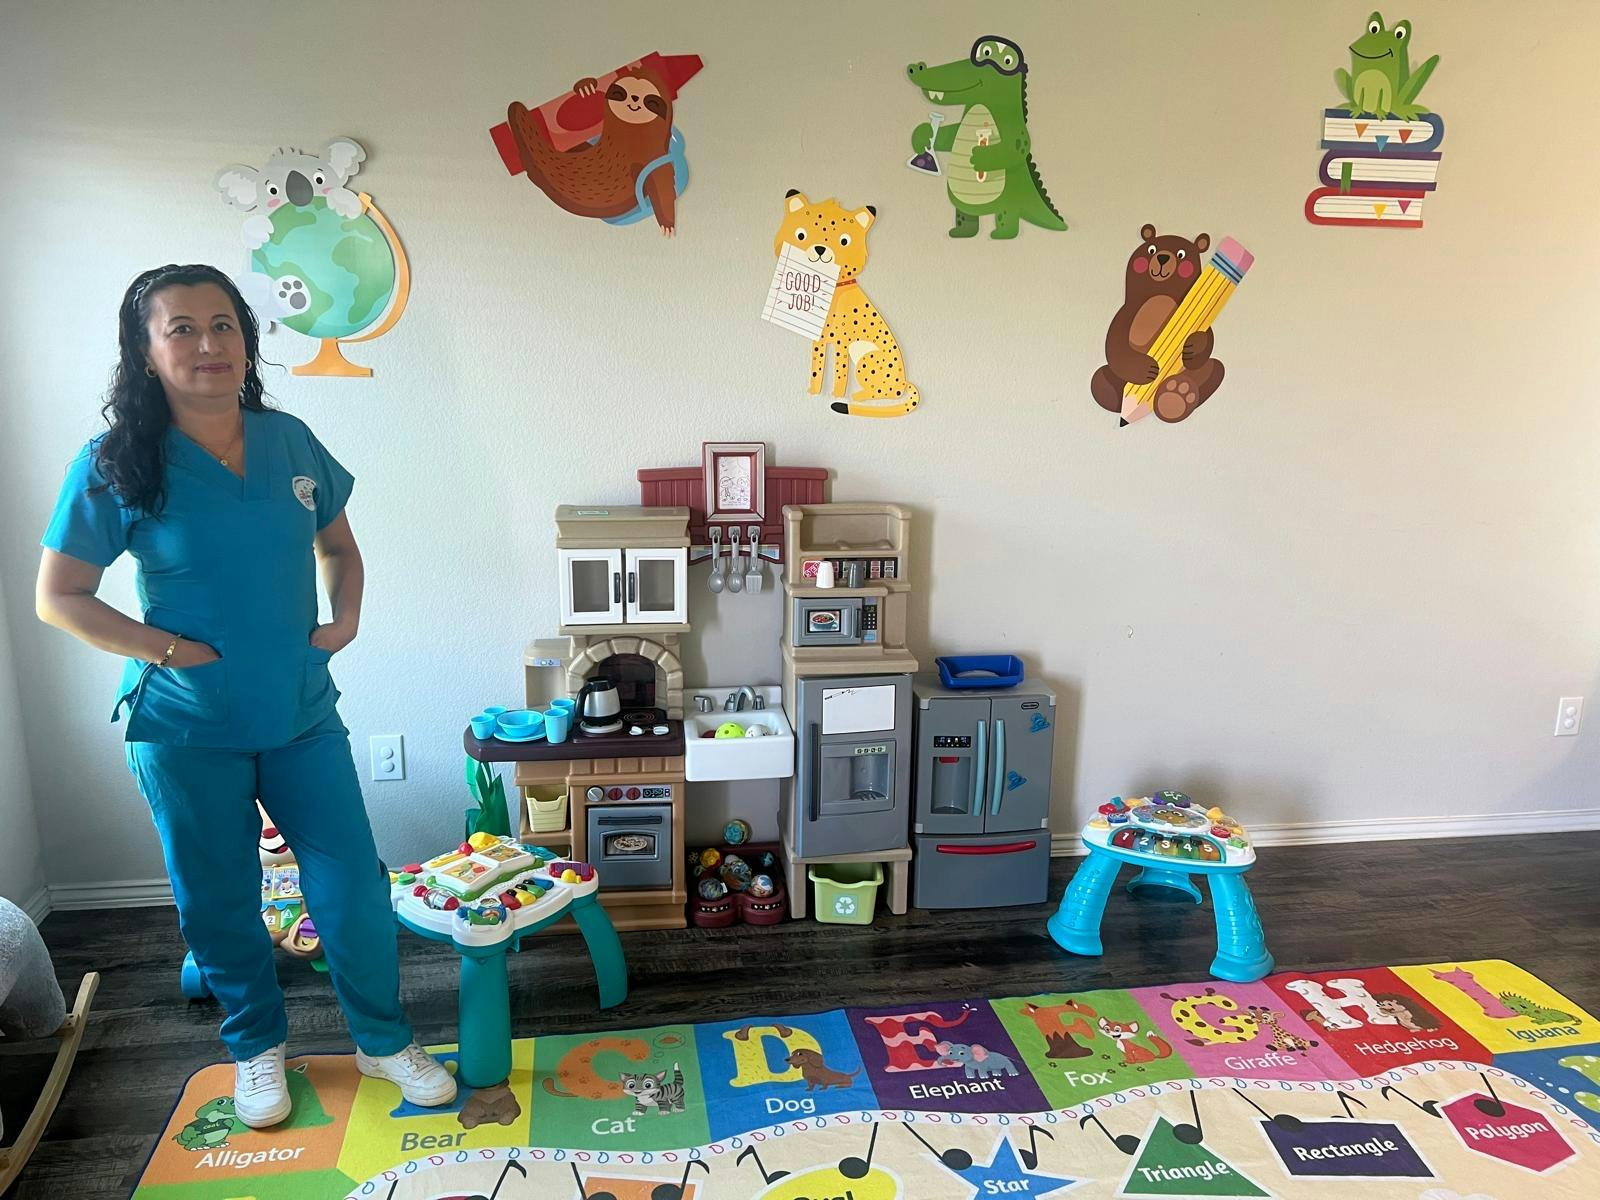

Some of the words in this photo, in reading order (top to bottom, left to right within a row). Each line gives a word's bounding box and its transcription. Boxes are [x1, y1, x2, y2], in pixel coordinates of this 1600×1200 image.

[785, 271, 821, 293] GOOD
[788, 293, 815, 312] JOB!
[1122, 832, 1130, 841] 1
[1139, 837, 1149, 846] 2
[1161, 840, 1171, 849] 3
[1183, 843, 1193, 852] 4
[1203, 844, 1213, 853] 5
[1506, 1025, 1581, 1043] Iguana
[1354, 1036, 1459, 1056] Hedgehog
[1224, 1052, 1298, 1071] Giraffe
[1063, 1070, 1113, 1087] Fox
[908, 1078, 1005, 1100] Elephant
[765, 1097, 816, 1114] Dog
[591, 1116, 637, 1135] Cat
[1465, 1119, 1550, 1141] Polygon
[401, 1132, 467, 1152] Bear
[1292, 1137, 1399, 1161] Rectangle
[195, 1147, 306, 1169] Alligator
[1137, 1160, 1231, 1183] Triangle
[983, 1178, 1030, 1195] Star
